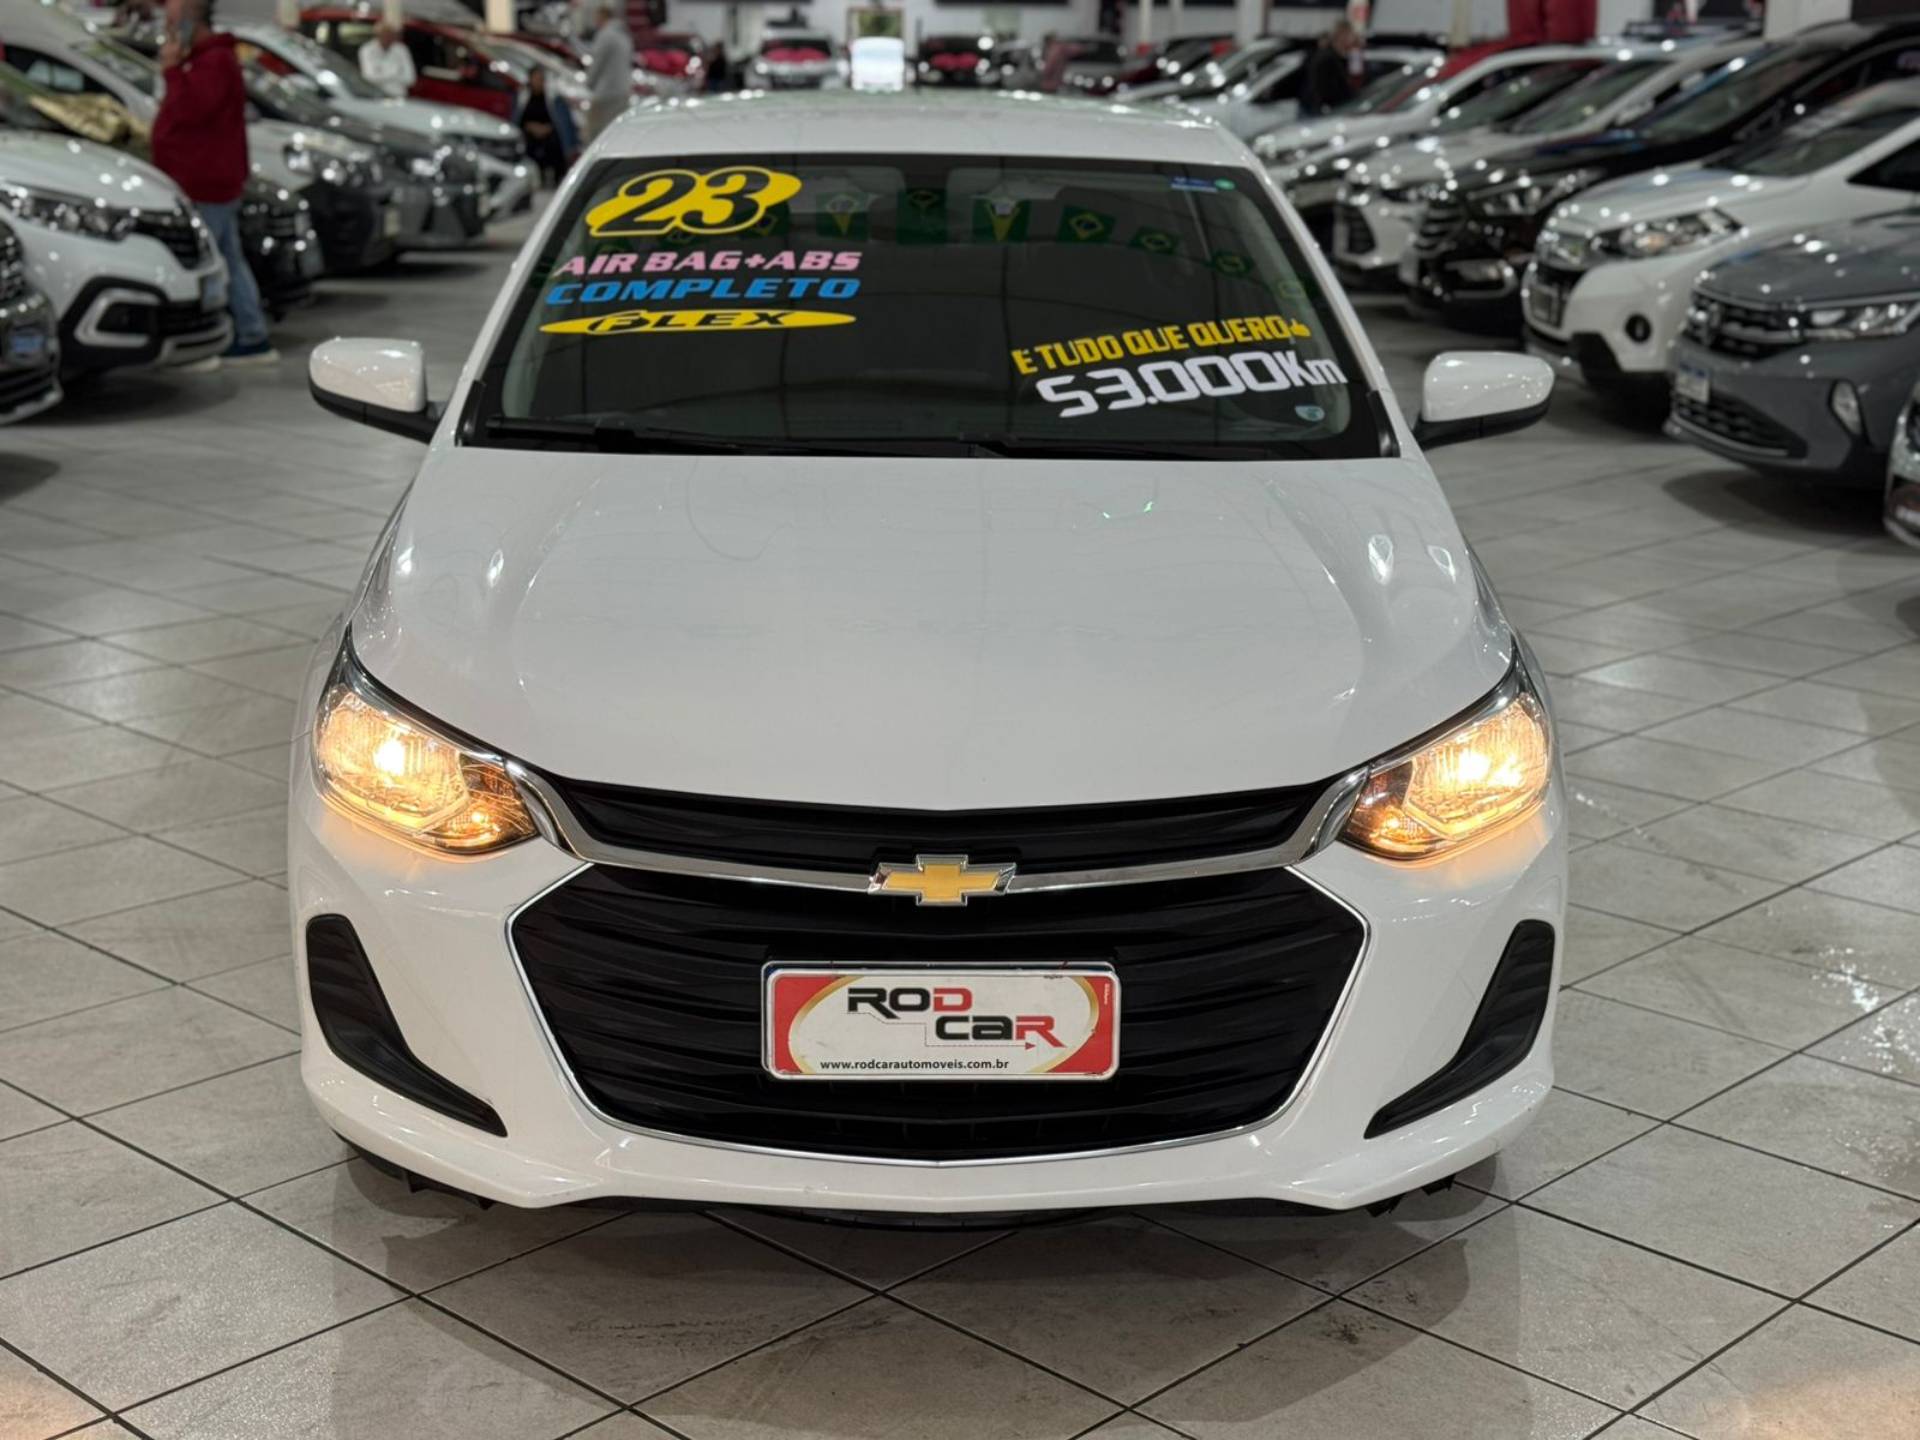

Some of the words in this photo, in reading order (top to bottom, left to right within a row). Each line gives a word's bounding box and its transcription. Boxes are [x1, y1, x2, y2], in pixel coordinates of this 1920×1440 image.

[590, 166, 772, 237] 23
[553, 253, 638, 277] AIR
[642, 250, 863, 274] BAG+ABS
[545, 277, 861, 305] COMPLETO
[587, 311, 795, 335] FLEX
[1033, 335, 1125, 370] TUDO
[1122, 325, 1190, 357] QUE
[1187, 314, 1292, 347] QUERO
[819, 1058, 1010, 1070] www.rodcarautomoveis.com.br
